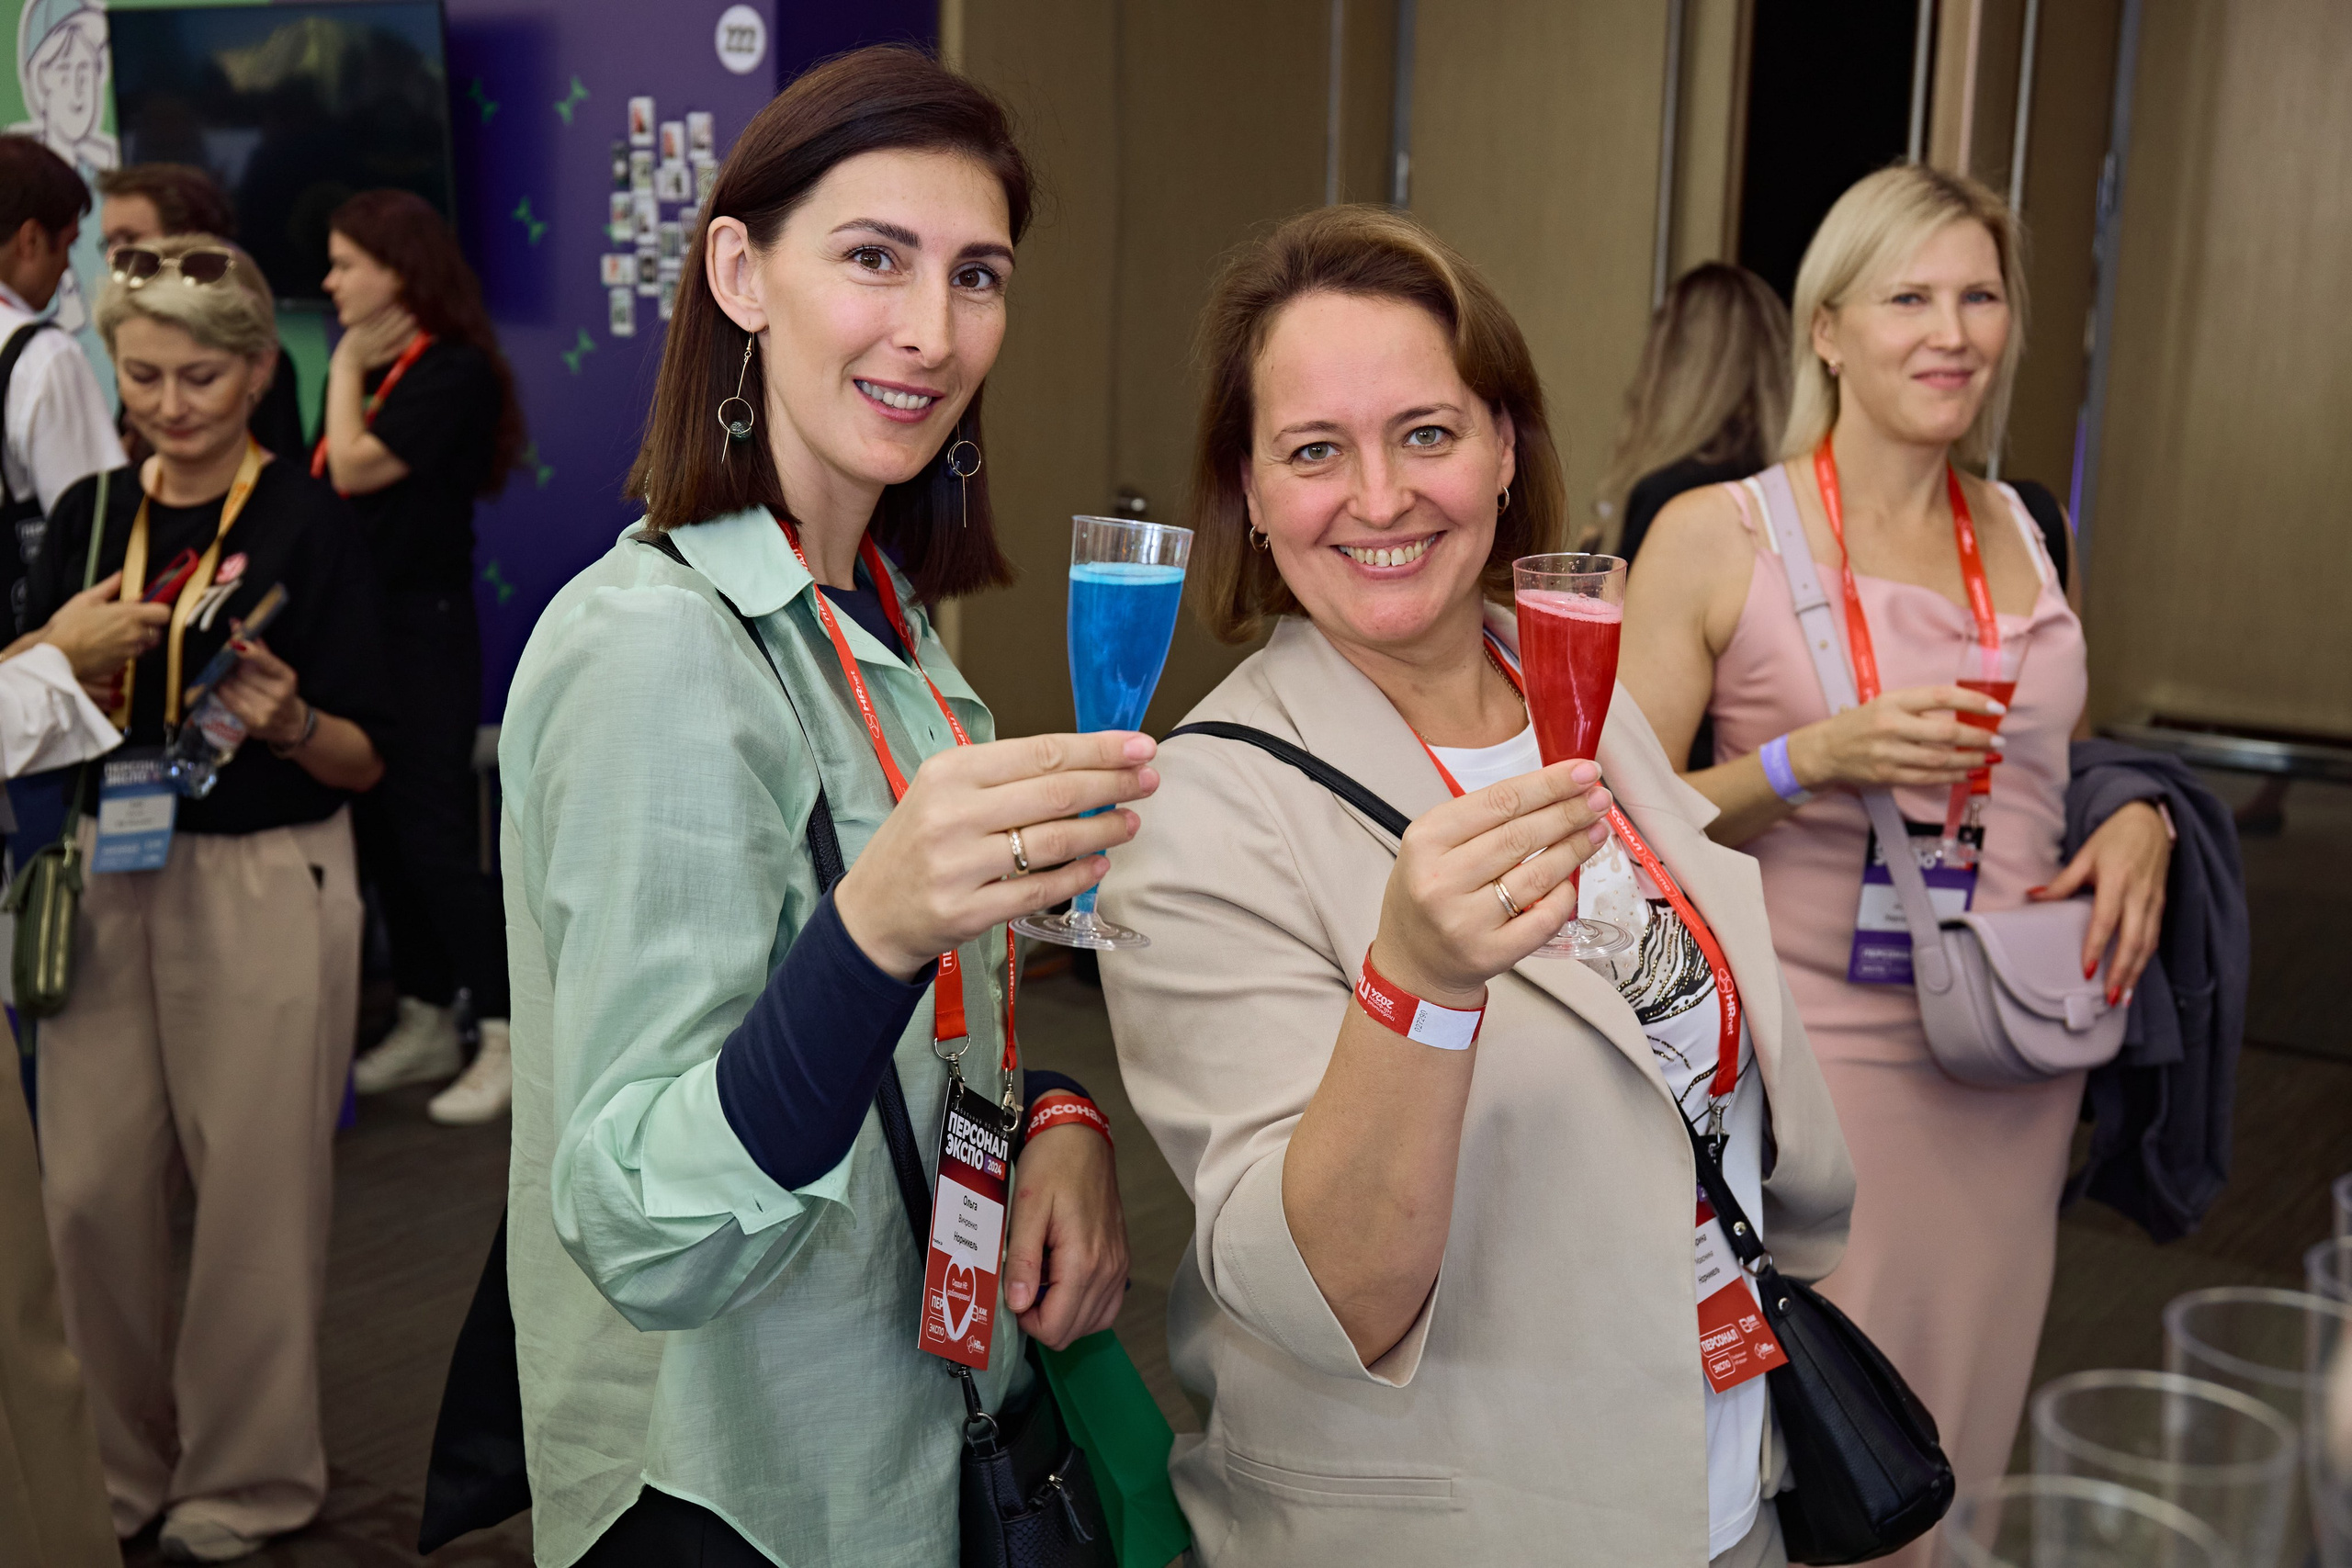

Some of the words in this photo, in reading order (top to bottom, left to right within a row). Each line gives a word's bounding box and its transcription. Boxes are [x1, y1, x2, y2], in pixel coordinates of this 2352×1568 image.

[1611, 806, 1643, 852] СОНАЛ
[1648, 862, 1670, 892] ЭКСПО
[1371, 987, 1394, 1010] 2024
[1725, 993, 1736, 1036] HRnet
[947, 1111, 1009, 1161] ПЕРСОНАЛ
[945, 1133, 984, 1170] ЭКСПО
[987, 1159, 1002, 1176] 2024
[963, 1195, 978, 1211] Ольга
[929, 1323, 944, 1337] ЭКСПО
[1701, 1328, 1738, 1353] ПЕРСОНАЛ
[1713, 1359, 1732, 1373] ЭКСПО
